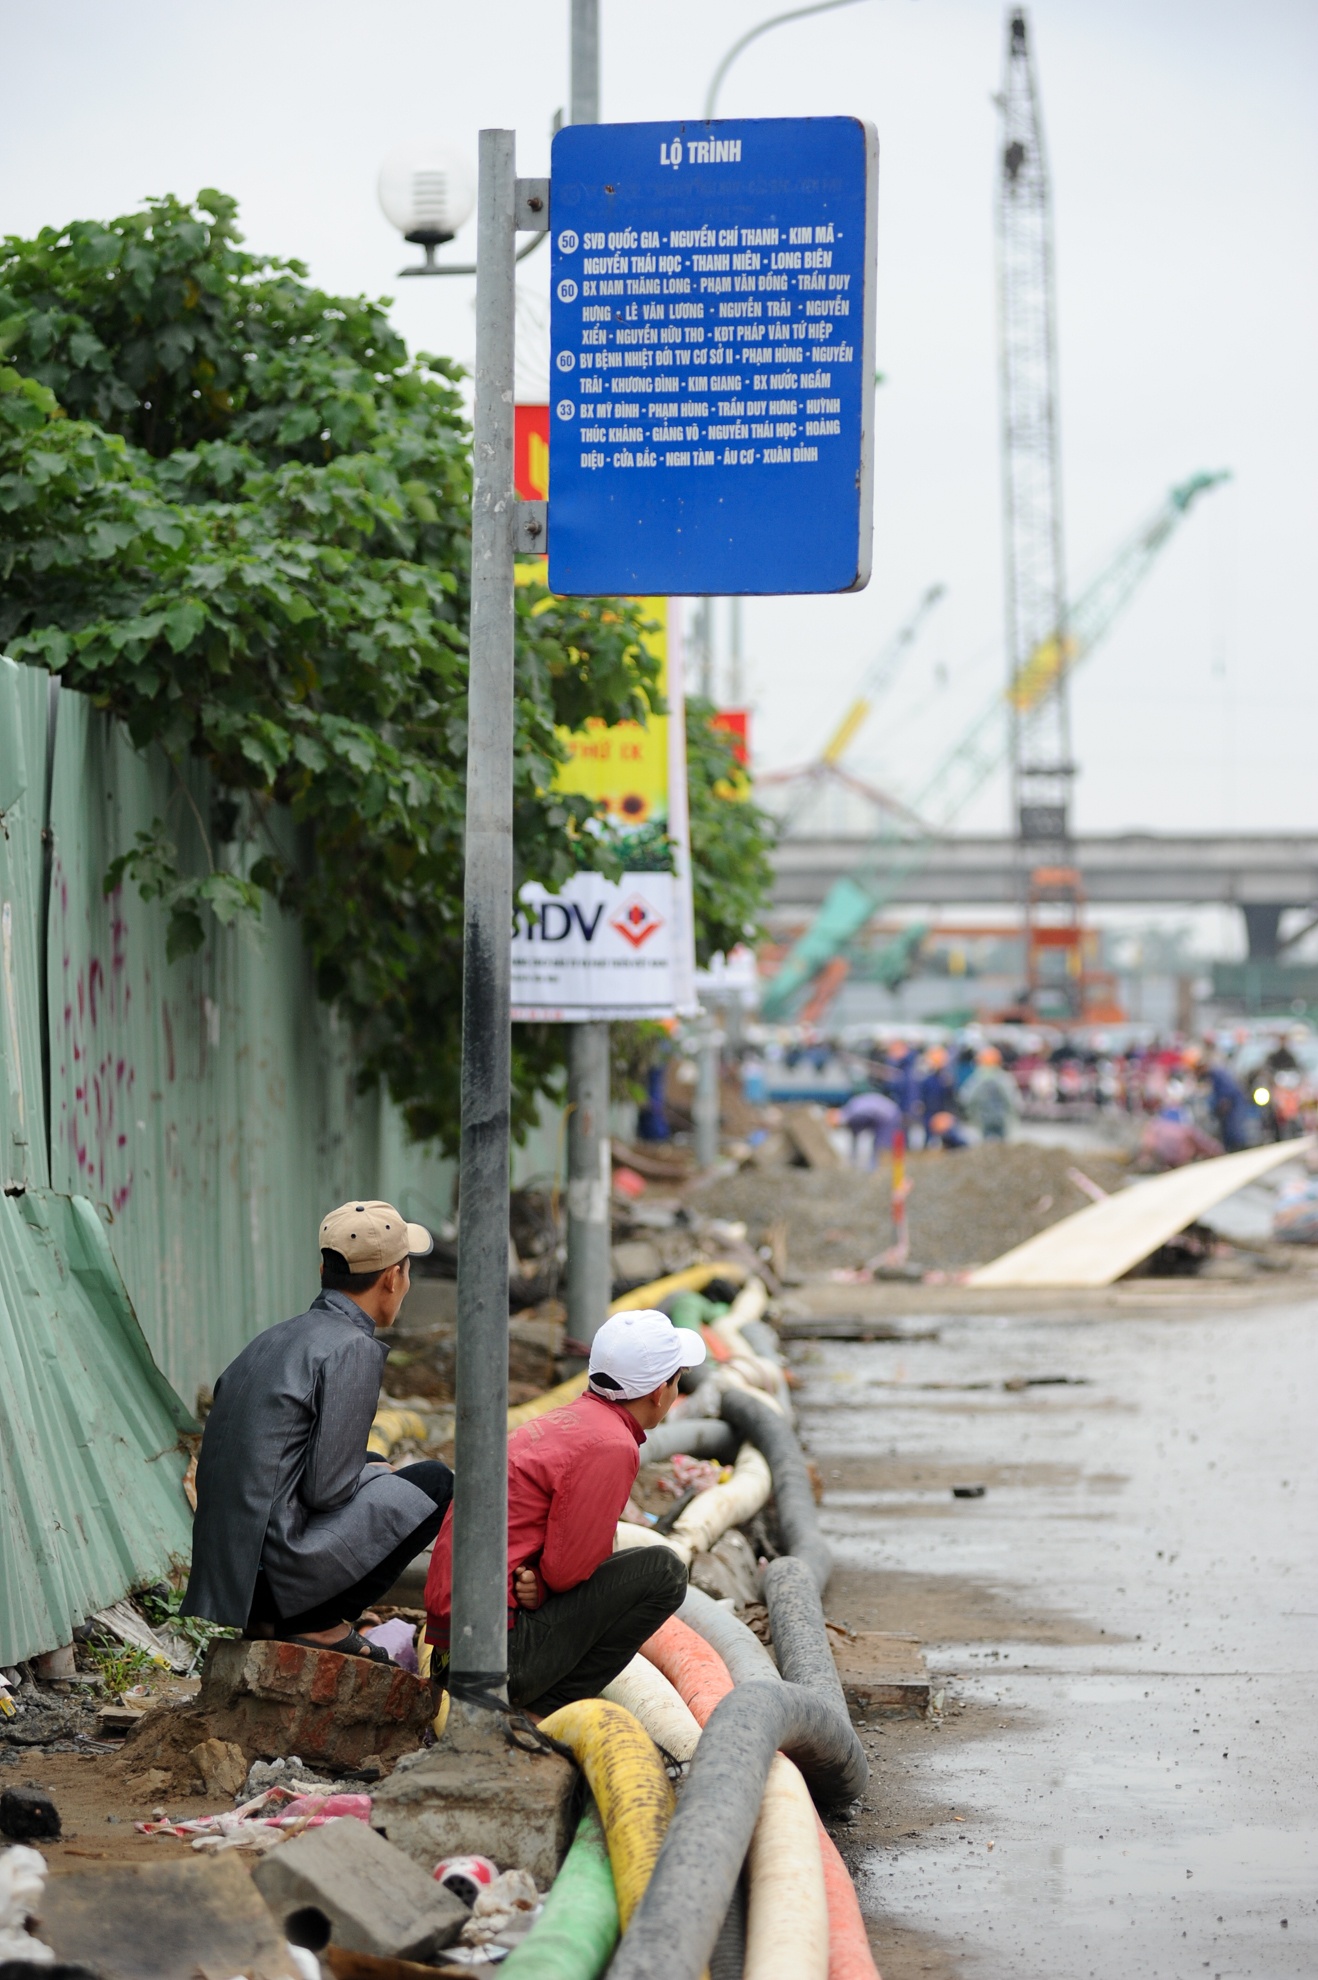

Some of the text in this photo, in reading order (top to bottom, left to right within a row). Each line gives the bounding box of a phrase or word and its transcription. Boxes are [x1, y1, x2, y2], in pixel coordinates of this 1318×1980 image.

[660, 135, 742, 170] LỘ TRÌNH
[562, 235, 575, 248] 50
[583, 232, 605, 250] SVĐ
[608, 227, 638, 250] QUỐC
[640, 231, 660, 248] GIA
[718, 226, 738, 247] CHÍ
[740, 229, 779, 246] THANH
[789, 227, 812, 244] KIM
[815, 223, 834, 243] MÃ
[631, 253, 656, 273] THÁI
[658, 255, 681, 275] HỌC
[692, 254, 730, 271] THANH
[732, 250, 760, 270] NIÊN
[770, 252, 801, 269] LONG
[804, 248, 832, 269] BIÊN
[562, 285, 574, 297] 60
[583, 281, 597, 296] BX
[599, 280, 624, 295] NAM
[626, 276, 660, 294] THĂNG
[663, 278, 691, 294] LONG
[700, 277, 732, 294] PHẠM
[734, 273, 756, 292] VĂN
[829, 274, 850, 290] DUY
[626, 302, 638, 320] LÊ
[643, 302, 664, 320] VĂN
[669, 302, 704, 319] LƯƠNG
[714, 326, 734, 341] KĐT
[737, 323, 765, 341] PHÁP
[768, 322, 790, 340] VÂN
[808, 321, 833, 342] HIỆP
[560, 355, 571, 367] 60
[580, 353, 593, 368] BV
[595, 349, 622, 370] BỆNH
[624, 348, 653, 369] NHIỆT
[675, 350, 691, 365] TW
[693, 348, 708, 364] CƠ
[709, 343, 724, 364] SỞ
[742, 348, 772, 366] PHẠM
[775, 344, 803, 363] HÙNG
[654, 374, 679, 392] ĐÌNH
[688, 376, 708, 391] KIM
[710, 375, 741, 391] GIANG
[754, 375, 767, 390] BX
[770, 369, 798, 389] NƯỚC
[560, 404, 572, 416] 33
[580, 404, 594, 418] BX
[614, 401, 639, 418] ĐÌNH
[648, 403, 678, 420] PHẠM
[680, 400, 708, 417] HÙNG
[746, 401, 768, 416] DUY
[580, 425, 606, 442] THÚC
[608, 425, 643, 442] KHÁNG
[686, 423, 699, 440] VÕ
[751, 420, 774, 438] THÁI
[776, 422, 796, 440] HỌC
[805, 418, 840, 436] HOÀNG
[581, 450, 604, 470] DIỆU
[666, 452, 690, 466] NGHI
[723, 448, 738, 465] ÂU
[740, 448, 755, 464] CƠ
[763, 446, 791, 463] XUÂN
